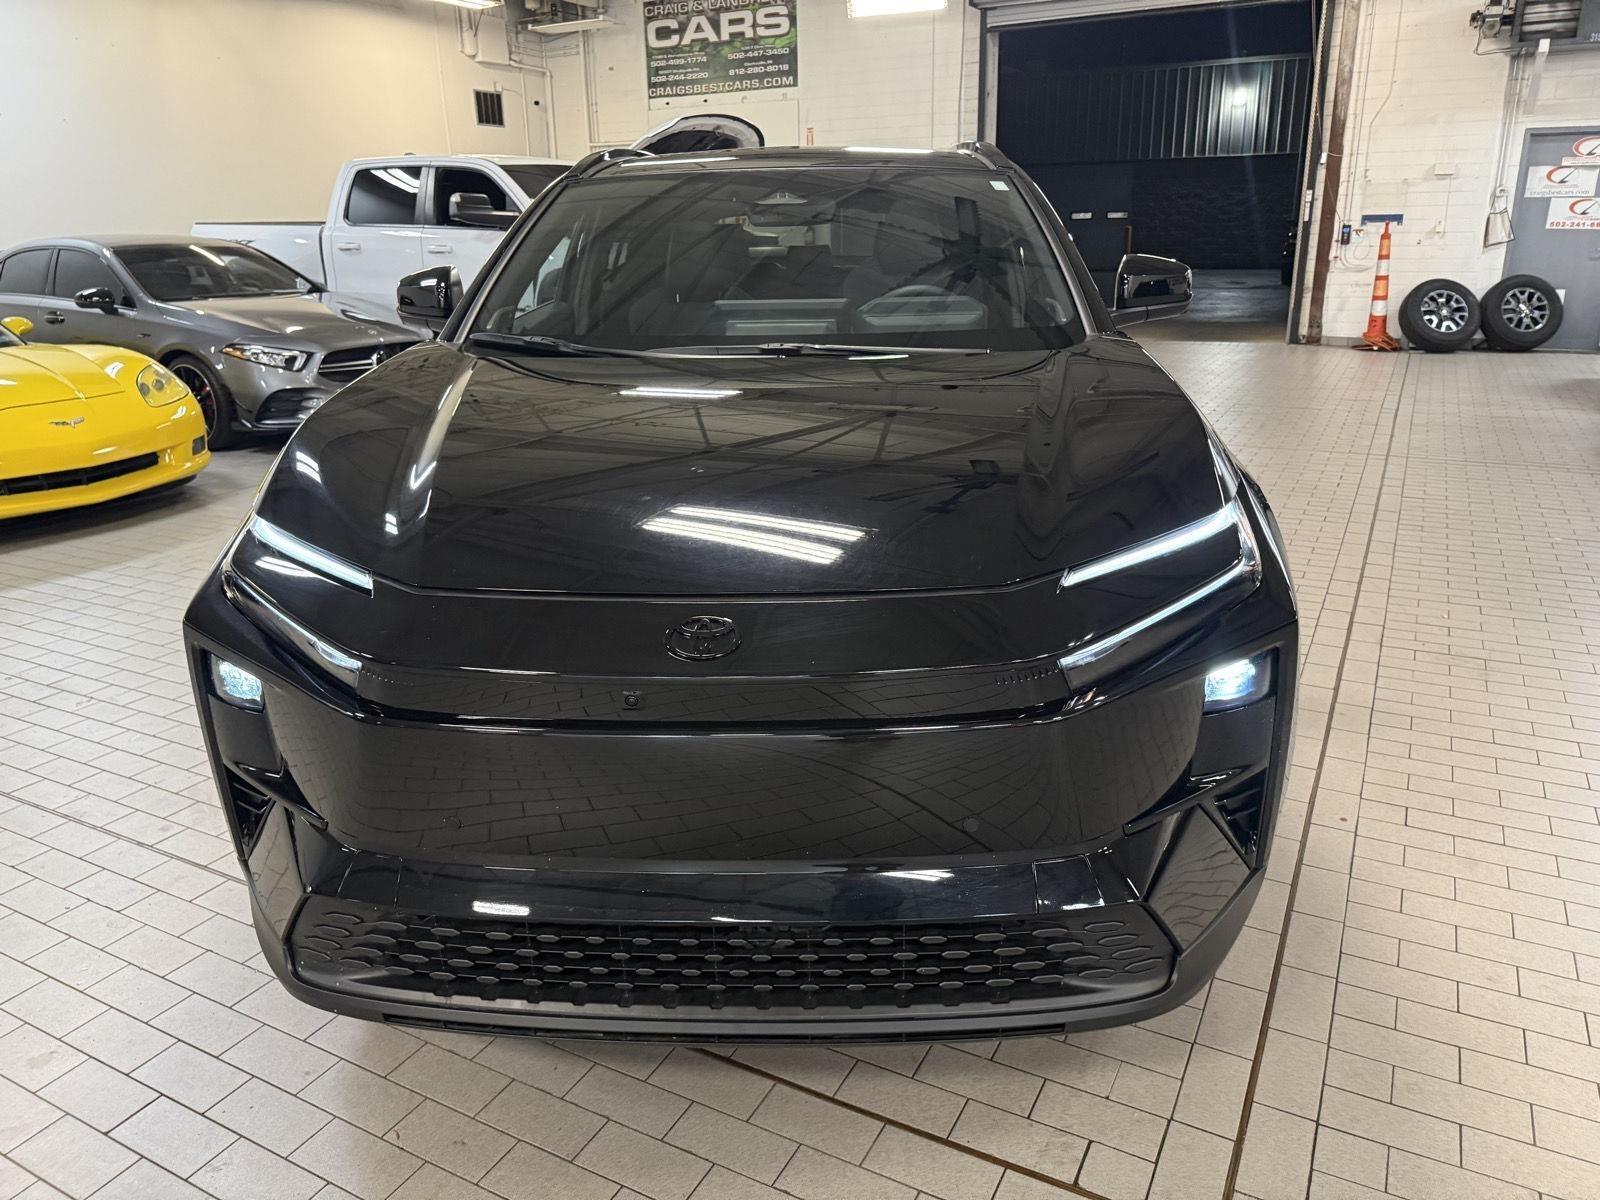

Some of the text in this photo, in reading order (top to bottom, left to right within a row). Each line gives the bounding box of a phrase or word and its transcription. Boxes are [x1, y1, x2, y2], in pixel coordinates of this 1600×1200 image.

[644, 2, 689, 17] CRAIG
[692, 0, 704, 11] &
[646, 5, 791, 49] CARS
[727, 47, 790, 60] 502-447-3450
[649, 76, 794, 97] CRAIGSBESTCARS.COM
